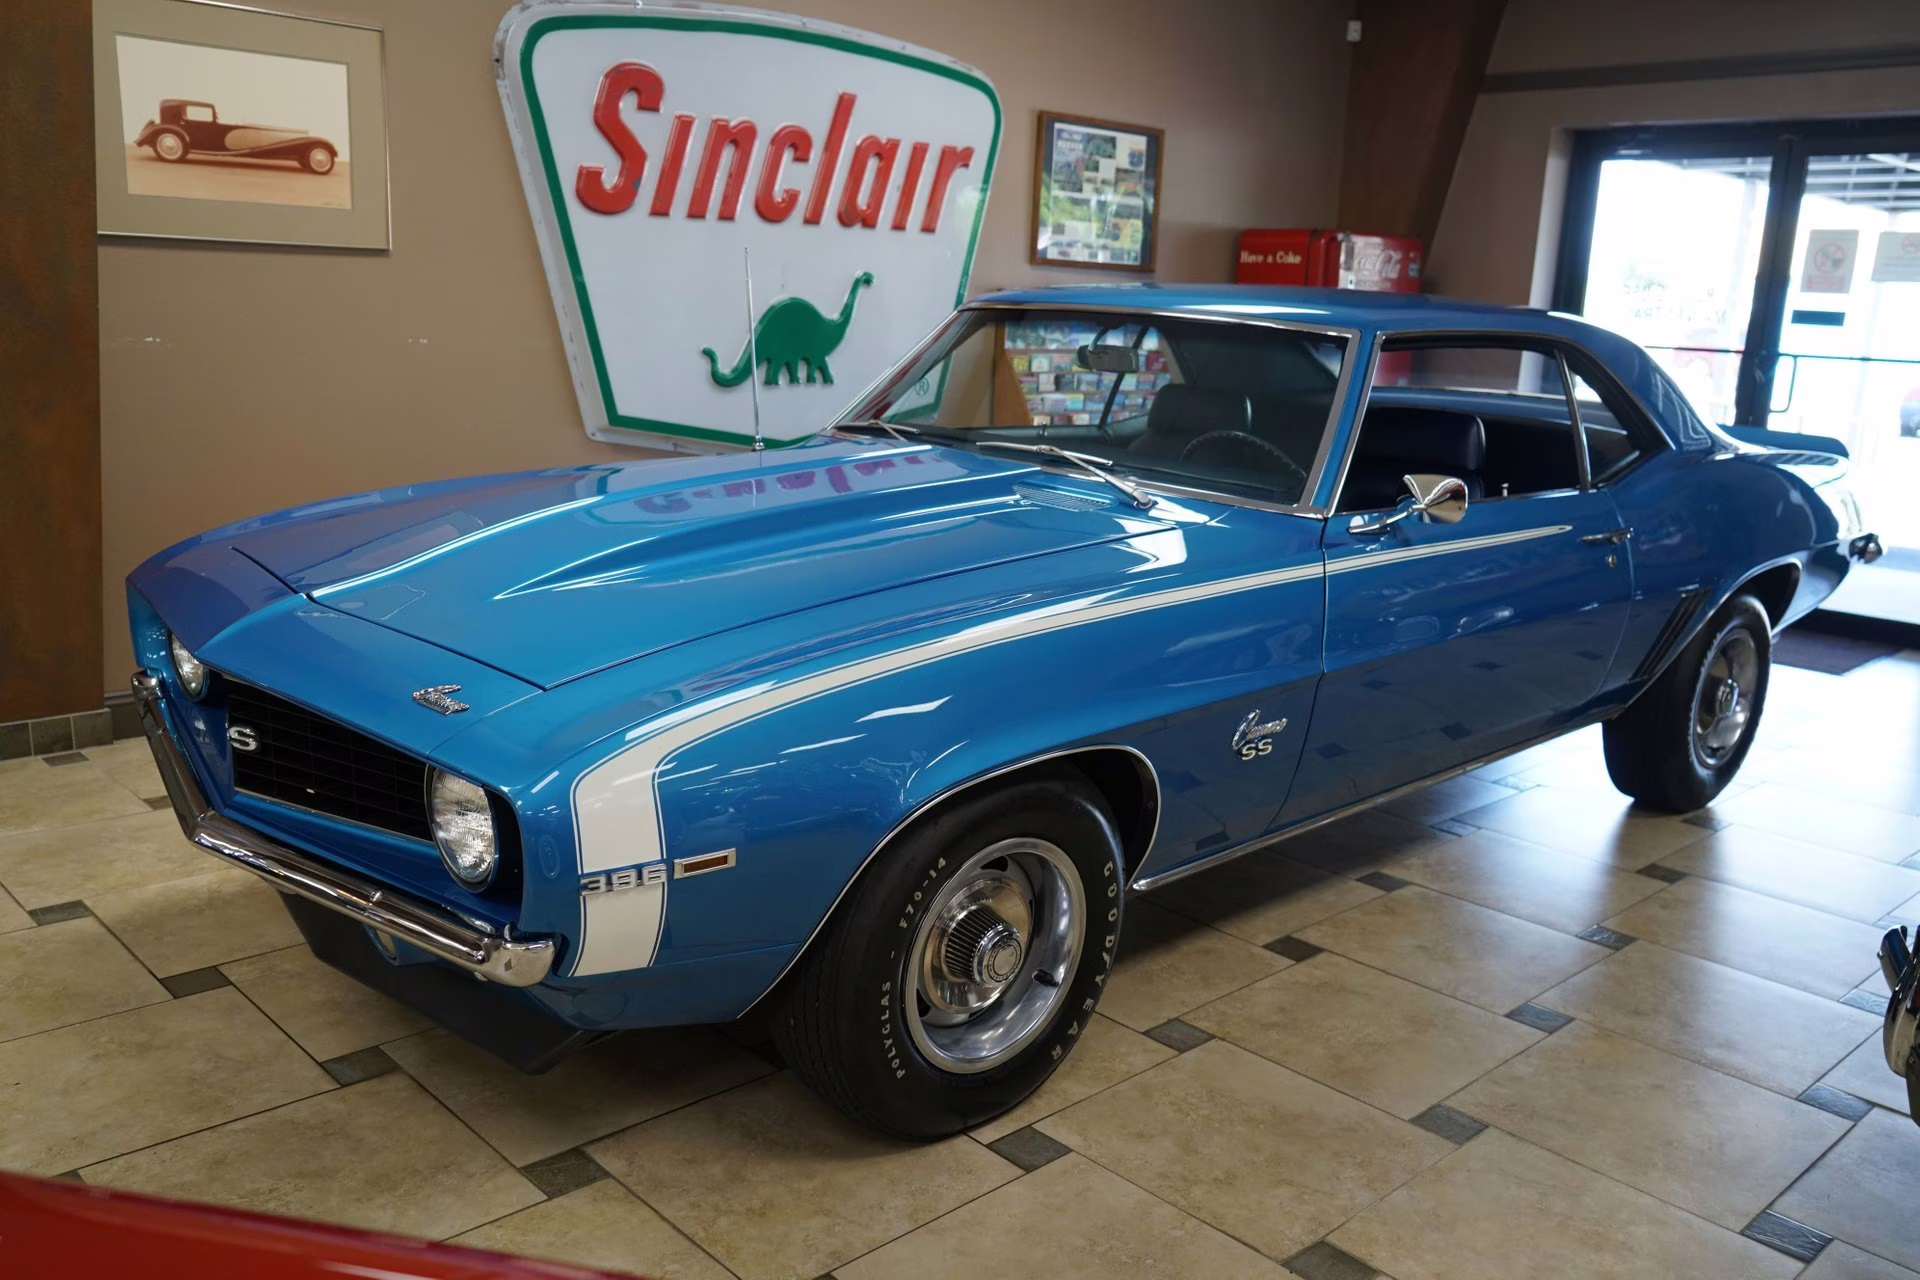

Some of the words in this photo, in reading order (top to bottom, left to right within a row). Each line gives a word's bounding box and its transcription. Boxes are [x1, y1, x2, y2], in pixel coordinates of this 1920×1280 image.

[575, 62, 975, 233] Sinclair
[1240, 250, 1264, 264] Have
[1266, 254, 1274, 264] a
[1276, 250, 1302, 264] Coke
[1241, 738, 1272, 761] SS
[580, 863, 668, 896] 396
[881, 981, 906, 1080] POLYGLAS
